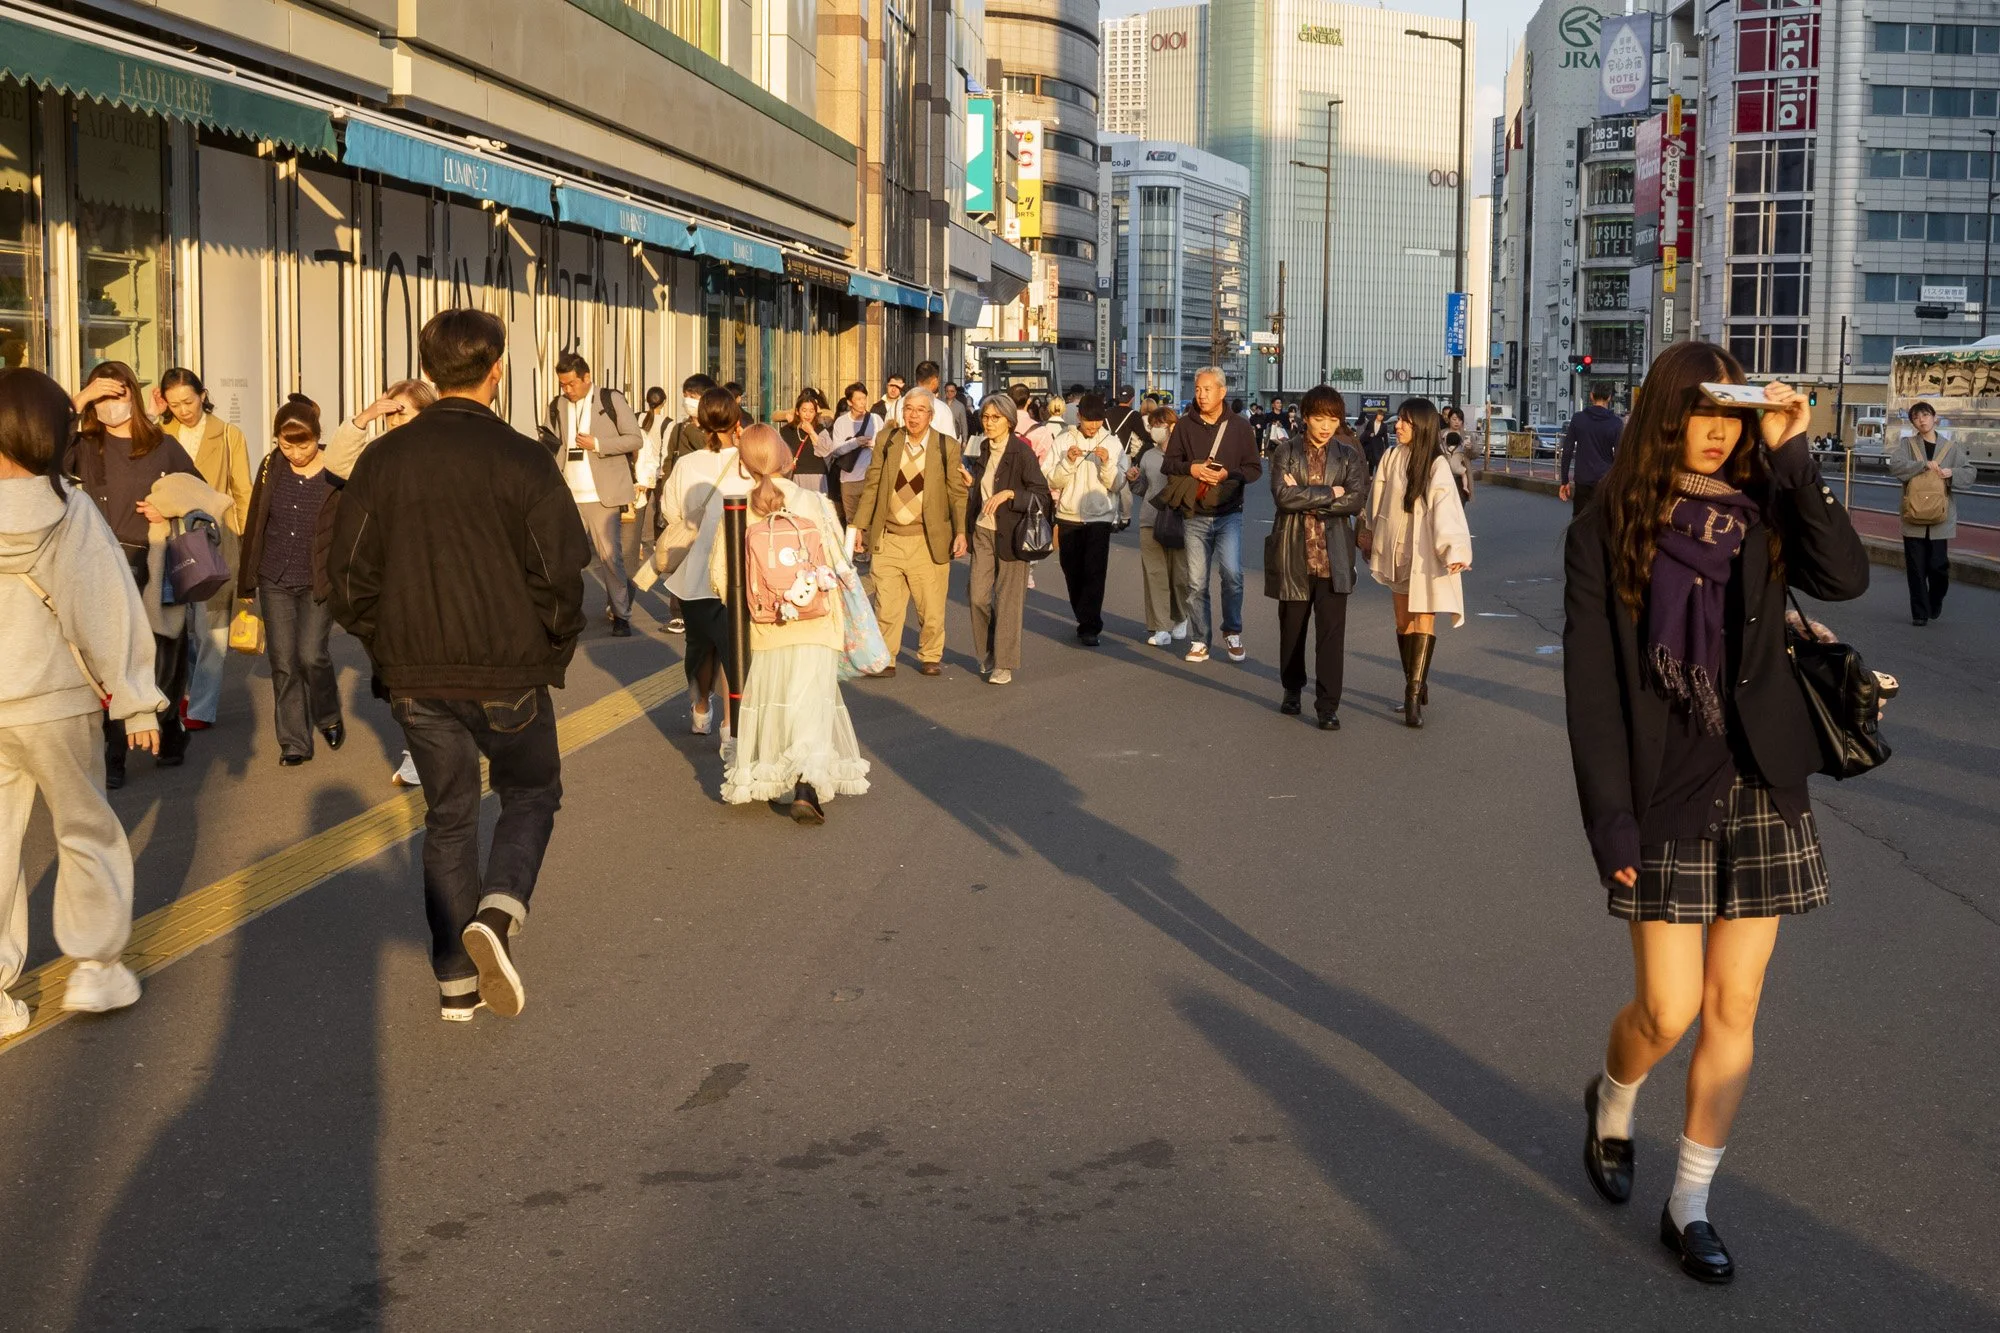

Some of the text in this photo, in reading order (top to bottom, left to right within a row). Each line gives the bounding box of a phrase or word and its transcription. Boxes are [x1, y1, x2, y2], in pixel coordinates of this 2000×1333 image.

[118, 61, 214, 119] LADURÉE
[1609, 73, 1640, 84] HOTEL
[1146, 150, 1177, 162] KEIO
[444, 157, 488, 192] LUMINE 2
[1558, 339, 1570, 421] 安心お宿
